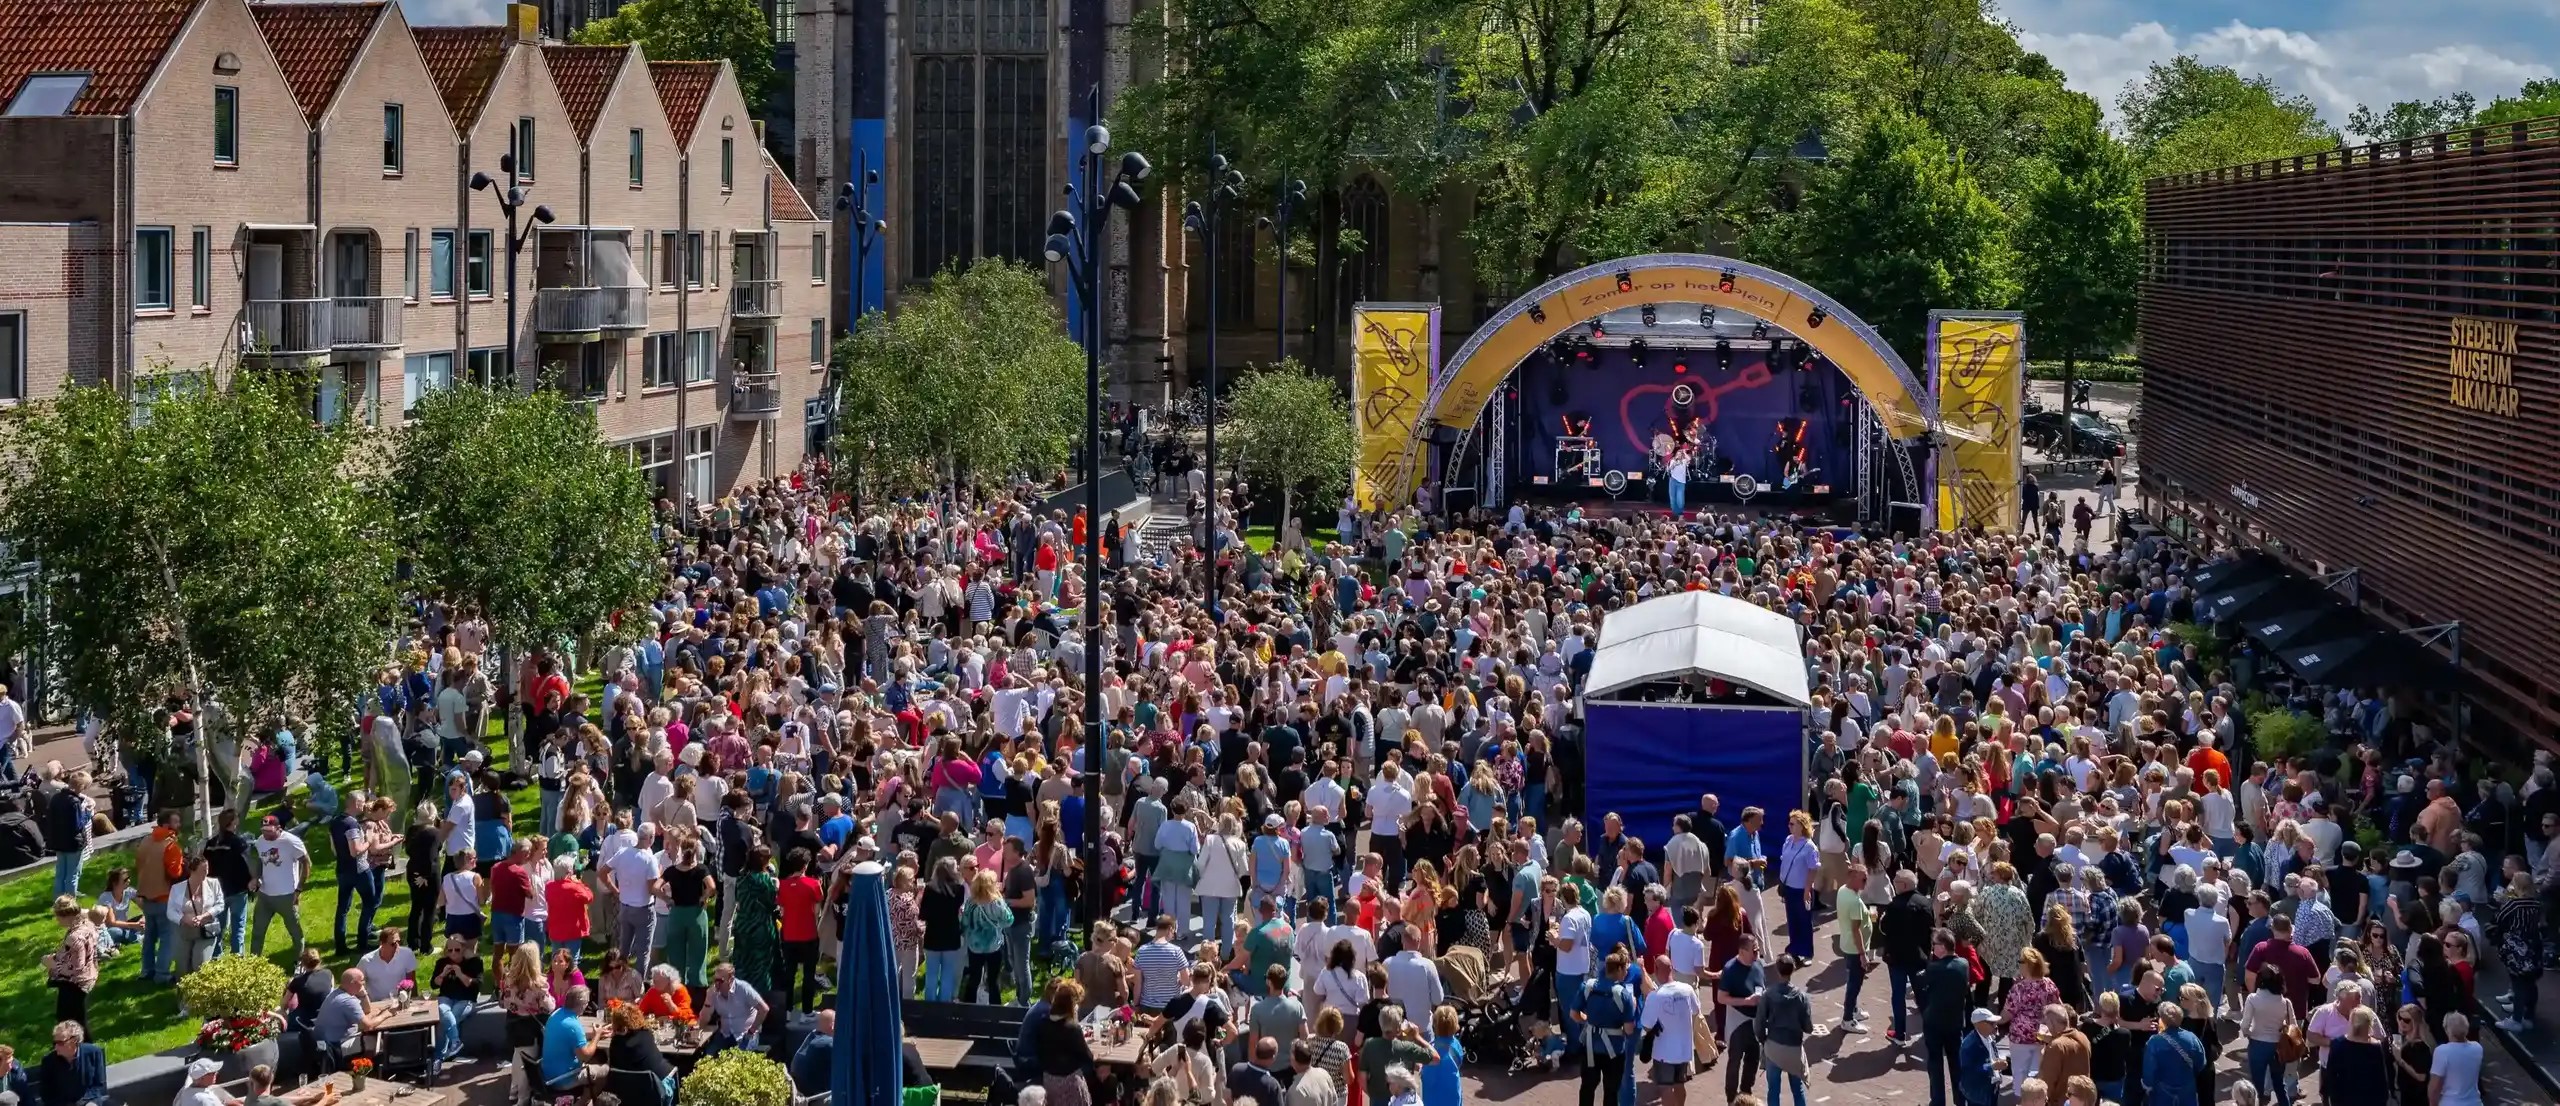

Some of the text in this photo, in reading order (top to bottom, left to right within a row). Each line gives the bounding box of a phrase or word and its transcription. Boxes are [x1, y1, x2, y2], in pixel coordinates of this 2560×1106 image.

[1579, 285, 1643, 306] Zomr
[1650, 282, 1675, 290] op
[1685, 280, 1719, 291] het
[2451, 317, 2518, 355] STEDELIJK
[2450, 348, 2512, 386] MUSEUM
[2450, 378, 2519, 419] ALKMAAR
